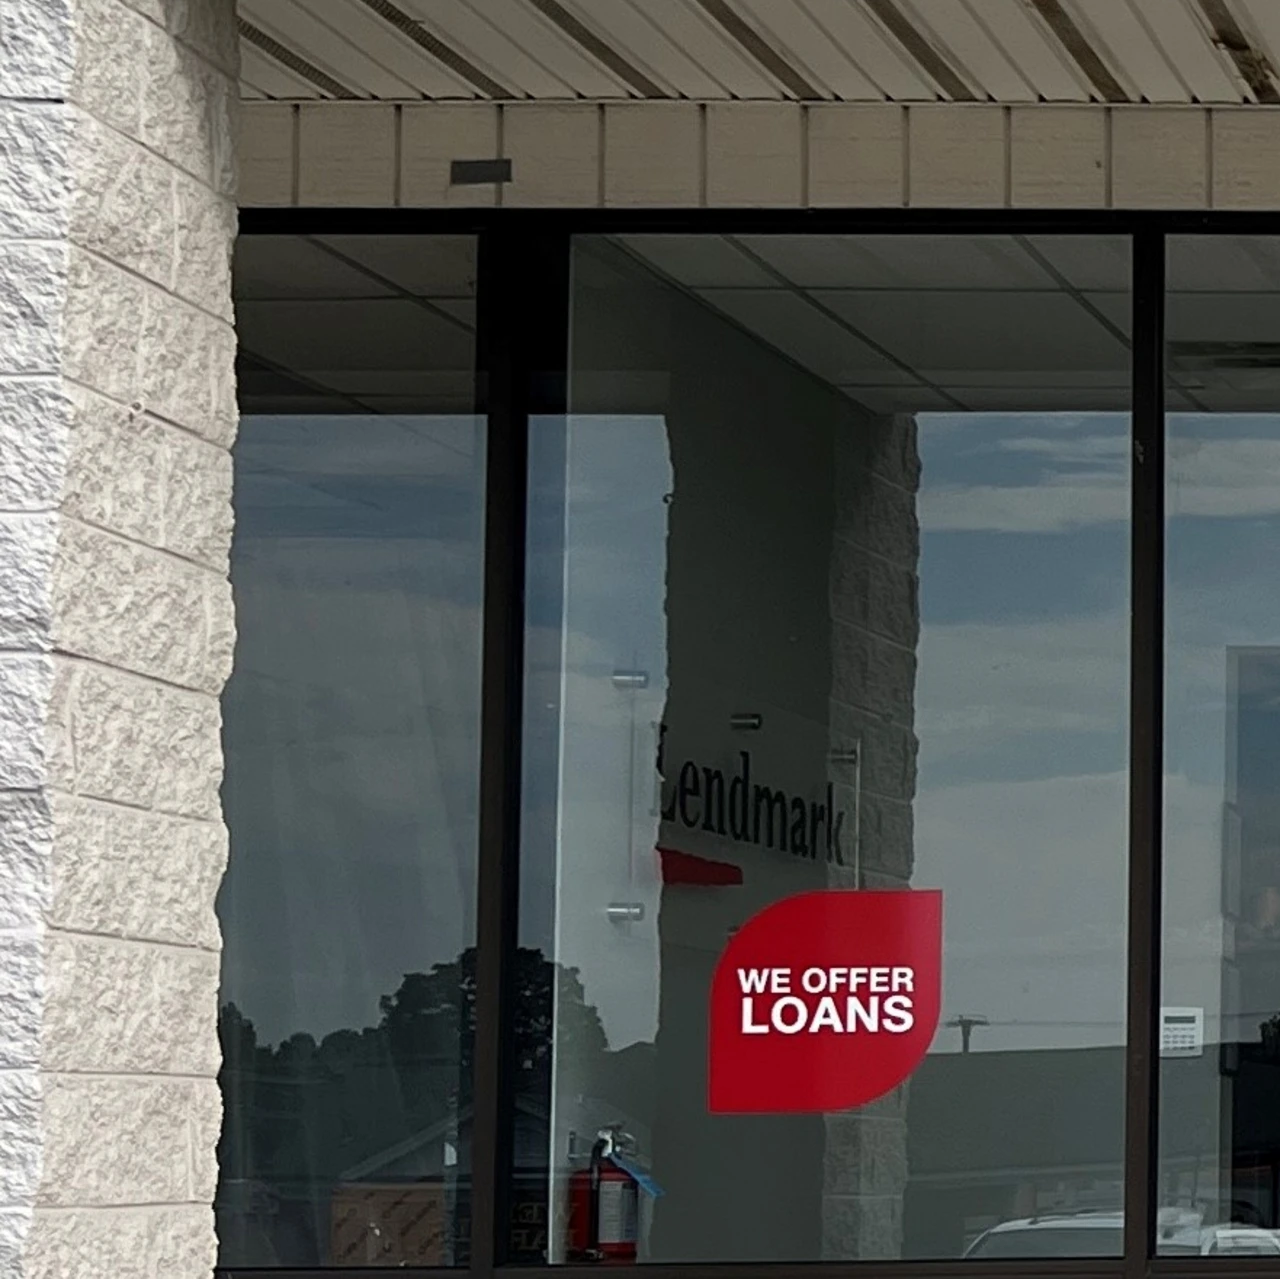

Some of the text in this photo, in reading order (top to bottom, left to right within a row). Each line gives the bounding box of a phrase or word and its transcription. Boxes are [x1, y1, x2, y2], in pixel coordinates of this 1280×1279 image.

[737, 967, 914, 994] WE OFFER
[741, 995, 914, 1034] LOANS
